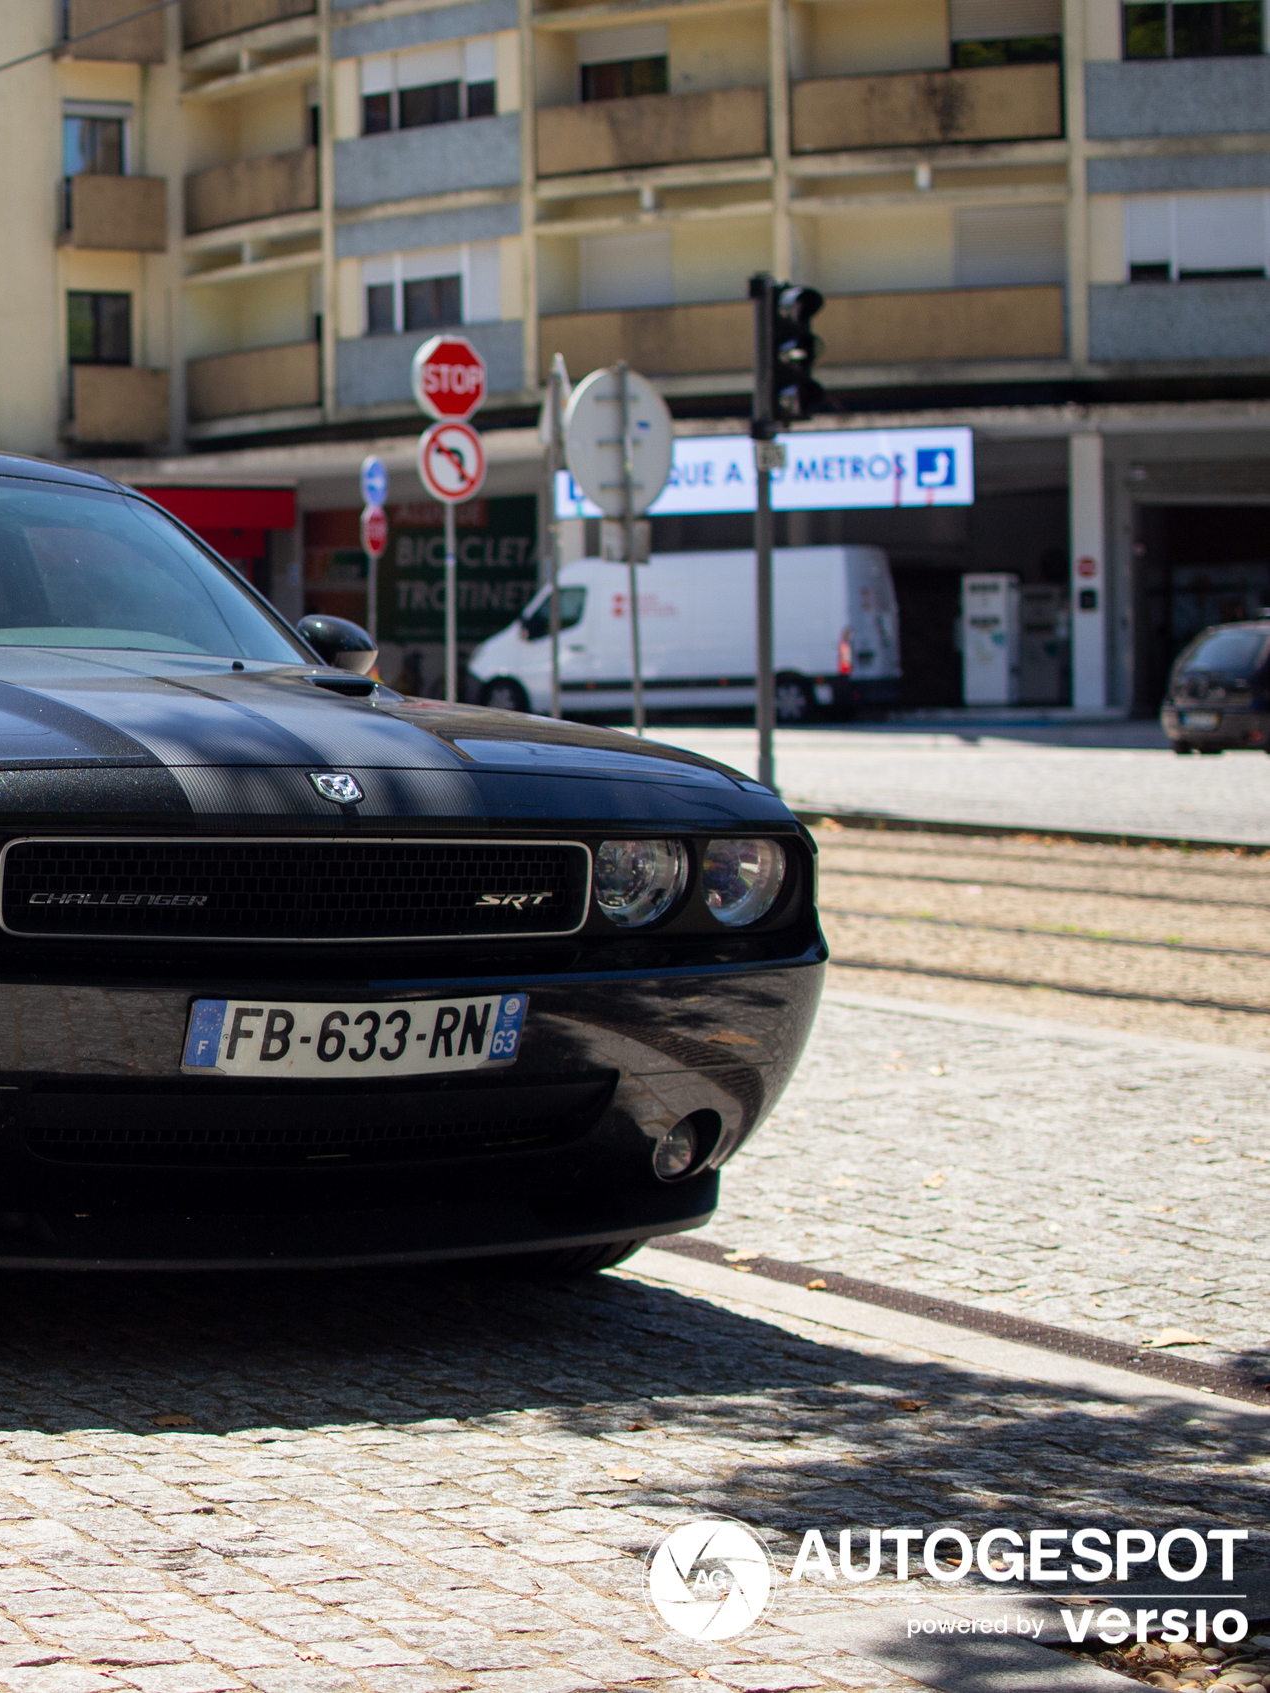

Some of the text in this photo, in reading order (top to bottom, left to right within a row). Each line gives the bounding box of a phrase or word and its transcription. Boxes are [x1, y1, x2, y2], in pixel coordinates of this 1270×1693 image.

[424, 363, 484, 395] STOP
[724, 461, 744, 484] A
[794, 453, 907, 482] METROS
[29, 893, 208, 906] CHALLENGER
[475, 892, 553, 910] SRT
[226, 1003, 492, 1063] FB-633-RN
[492, 1029, 517, 1054] 63
[197, 1040, 209, 1055] F
